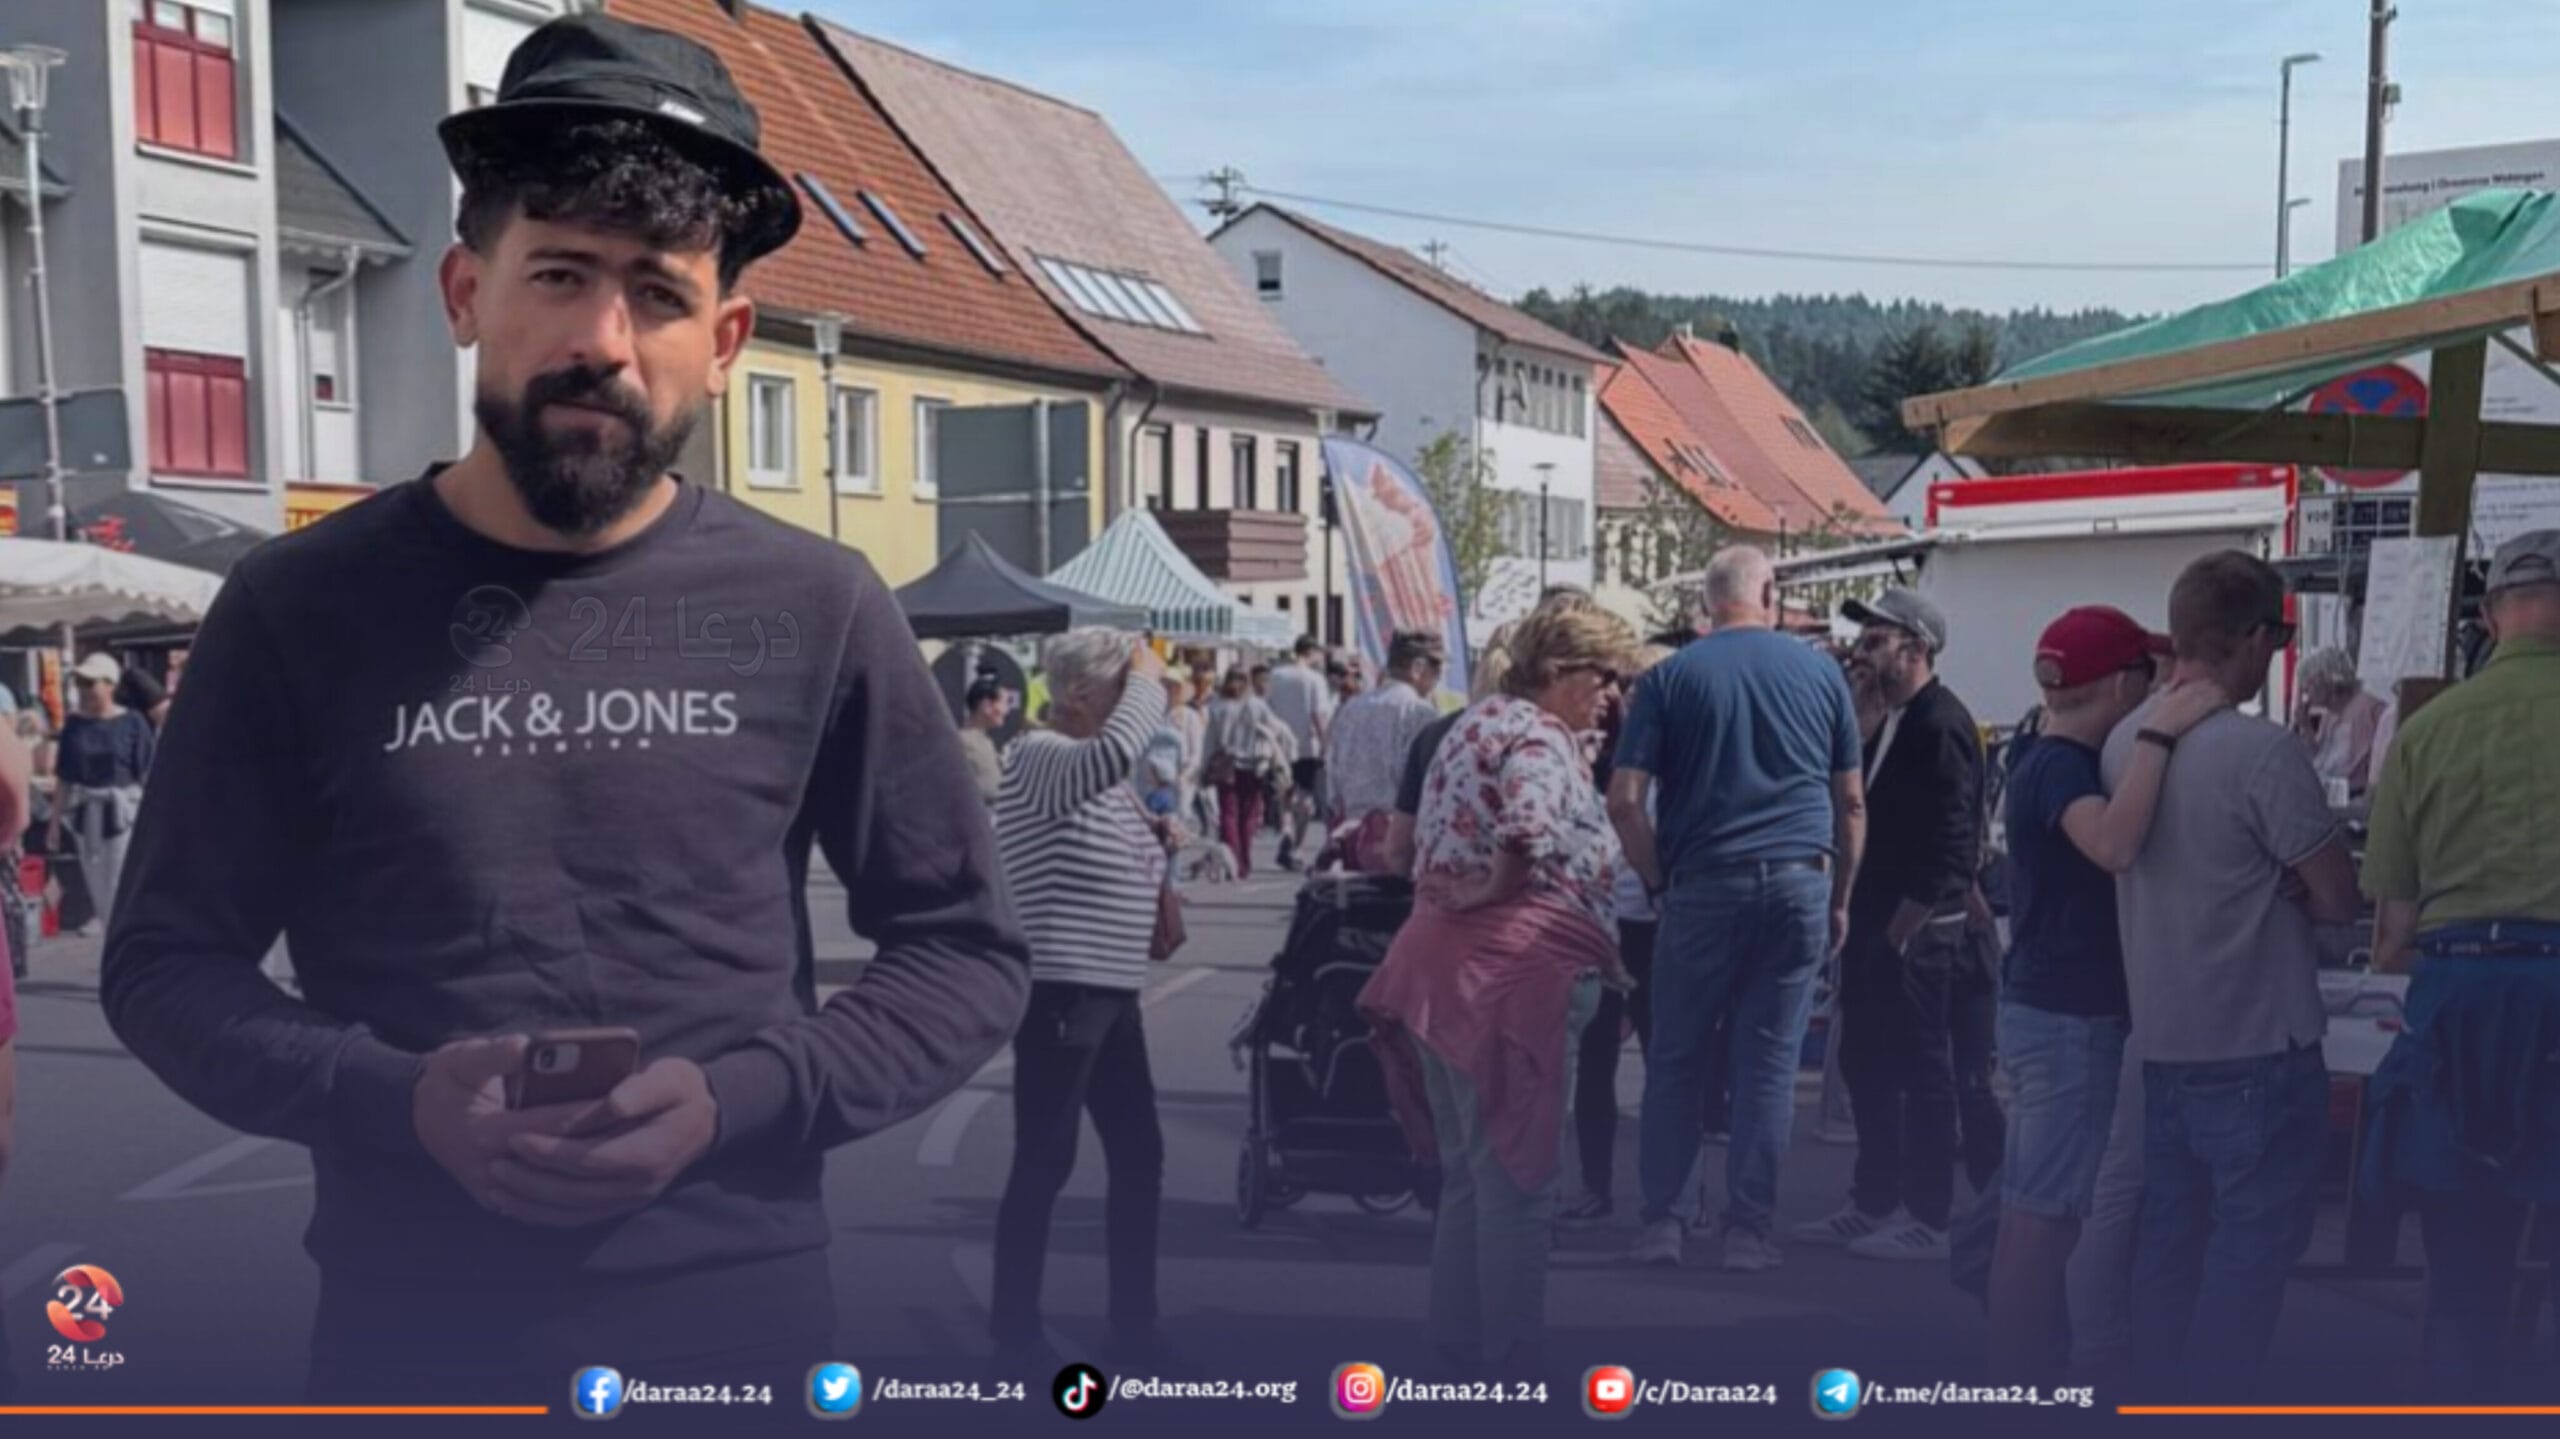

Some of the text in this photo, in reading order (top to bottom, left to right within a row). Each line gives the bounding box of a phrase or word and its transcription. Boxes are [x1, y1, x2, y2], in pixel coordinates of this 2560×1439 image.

[384, 695, 513, 751] JACK
[525, 692, 562, 737] &
[575, 689, 739, 735] JONES
